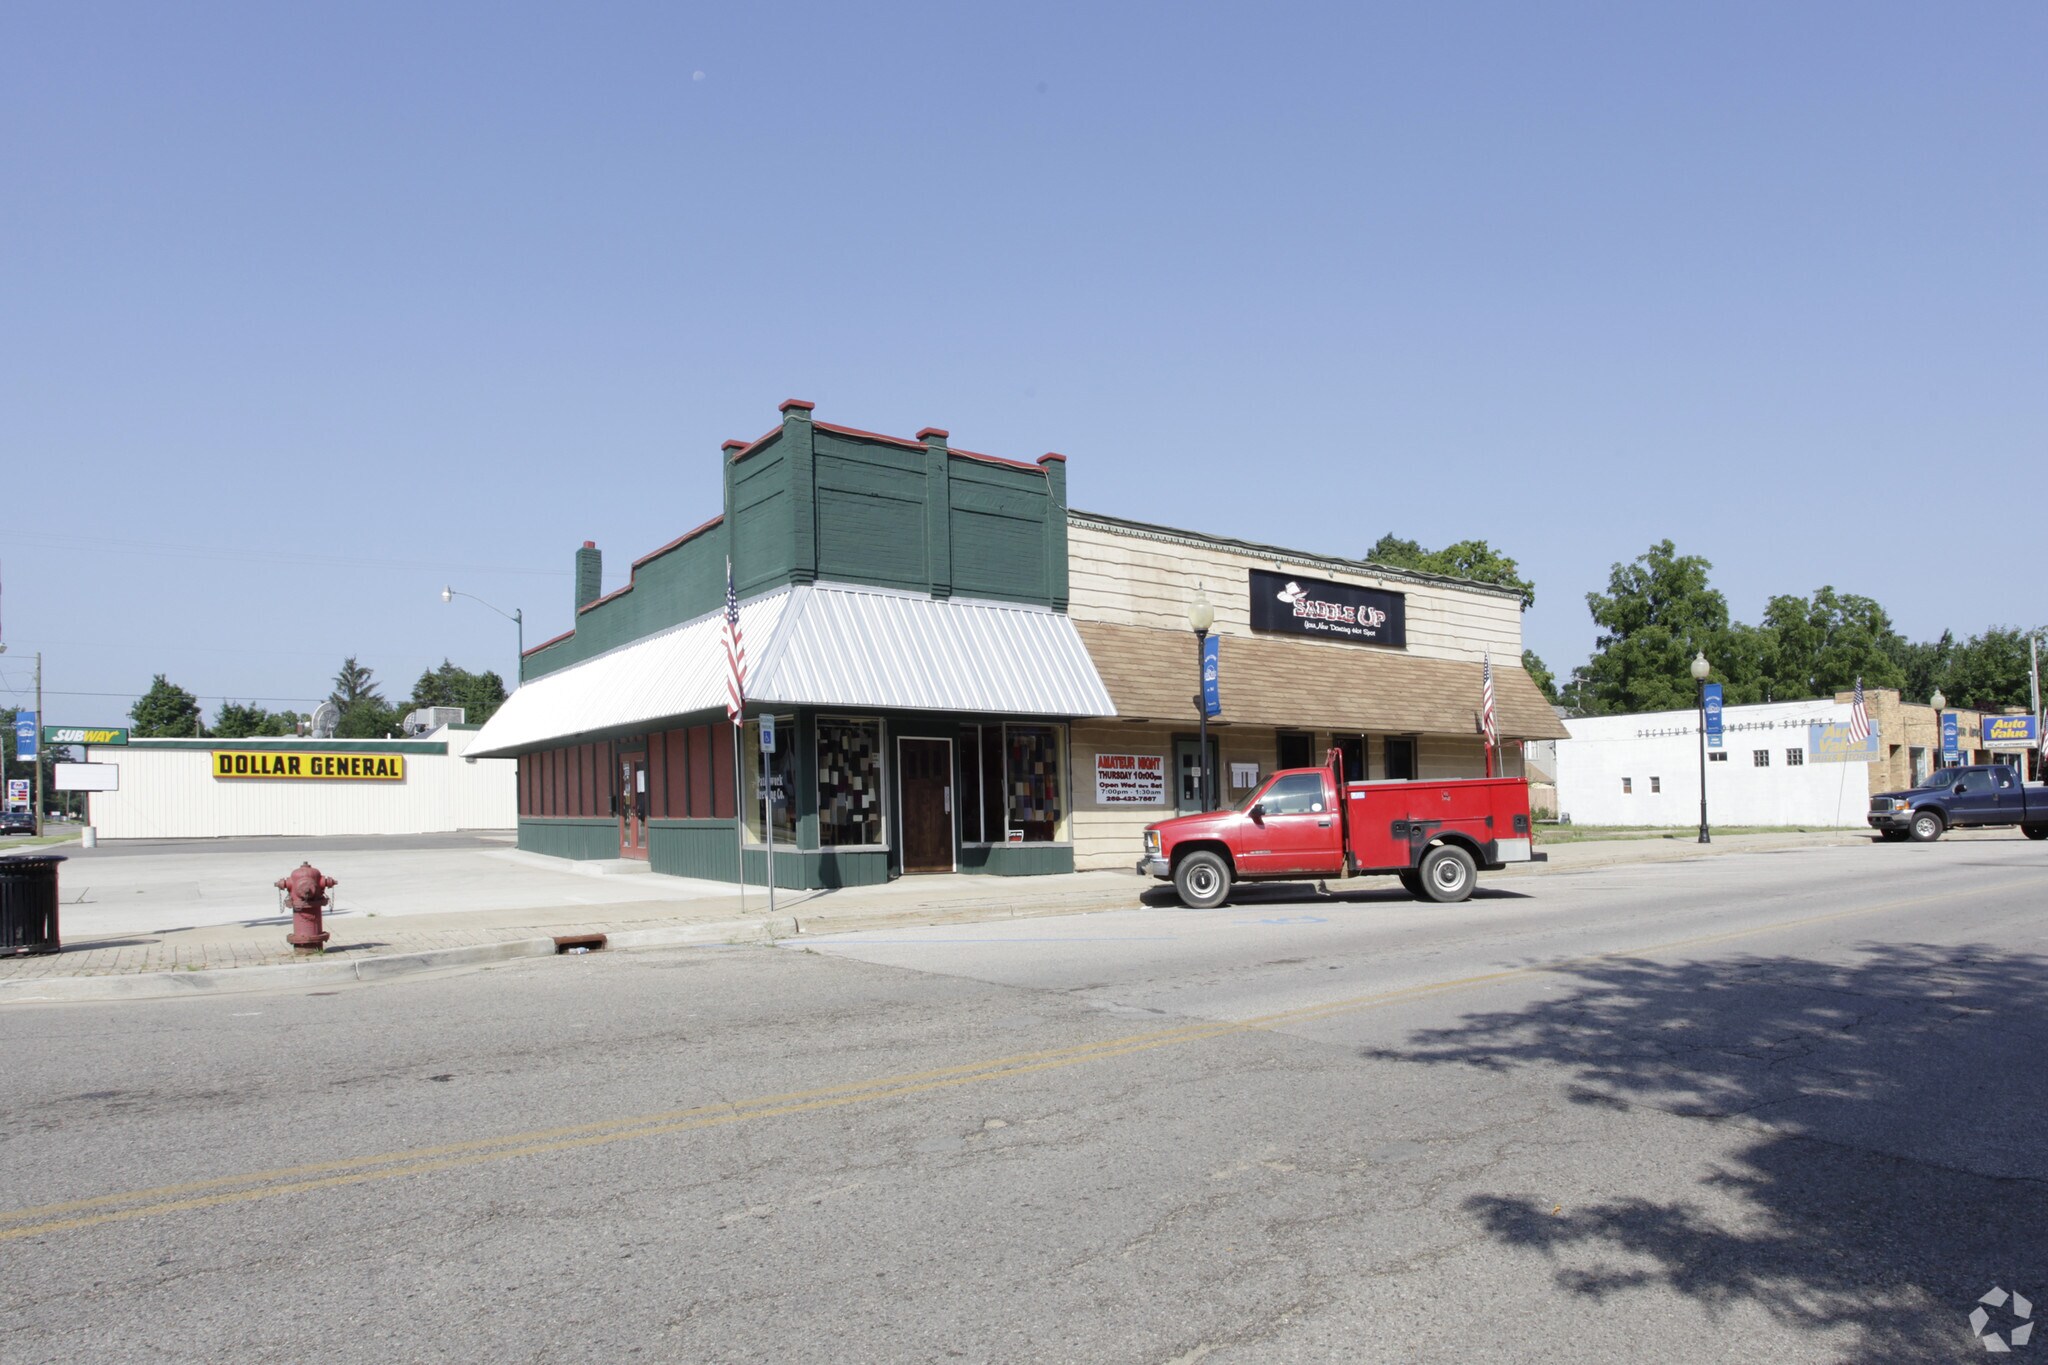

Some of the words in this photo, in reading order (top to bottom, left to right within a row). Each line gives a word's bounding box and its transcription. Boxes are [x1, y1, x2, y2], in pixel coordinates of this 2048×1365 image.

[1293, 598, 1356, 624] SADDLE
[1357, 605, 1386, 628] UP
[1330, 624, 1350, 634] Dancing
[1363, 629, 1376, 637] Spot
[1637, 726, 1688, 738] DECATUR
[1783, 718, 1834, 729] SUPPLY
[1992, 719, 2027, 729] Auto
[52, 729, 120, 743] SUBWAY
[1990, 728, 2029, 739] Value
[219, 754, 301, 775] DOLLAR
[311, 756, 399, 776] GENERAL
[1098, 756, 1135, 769] AMATEUR
[1138, 757, 1161, 770] NIGHT
[1098, 771, 1132, 780] THURSDAY
